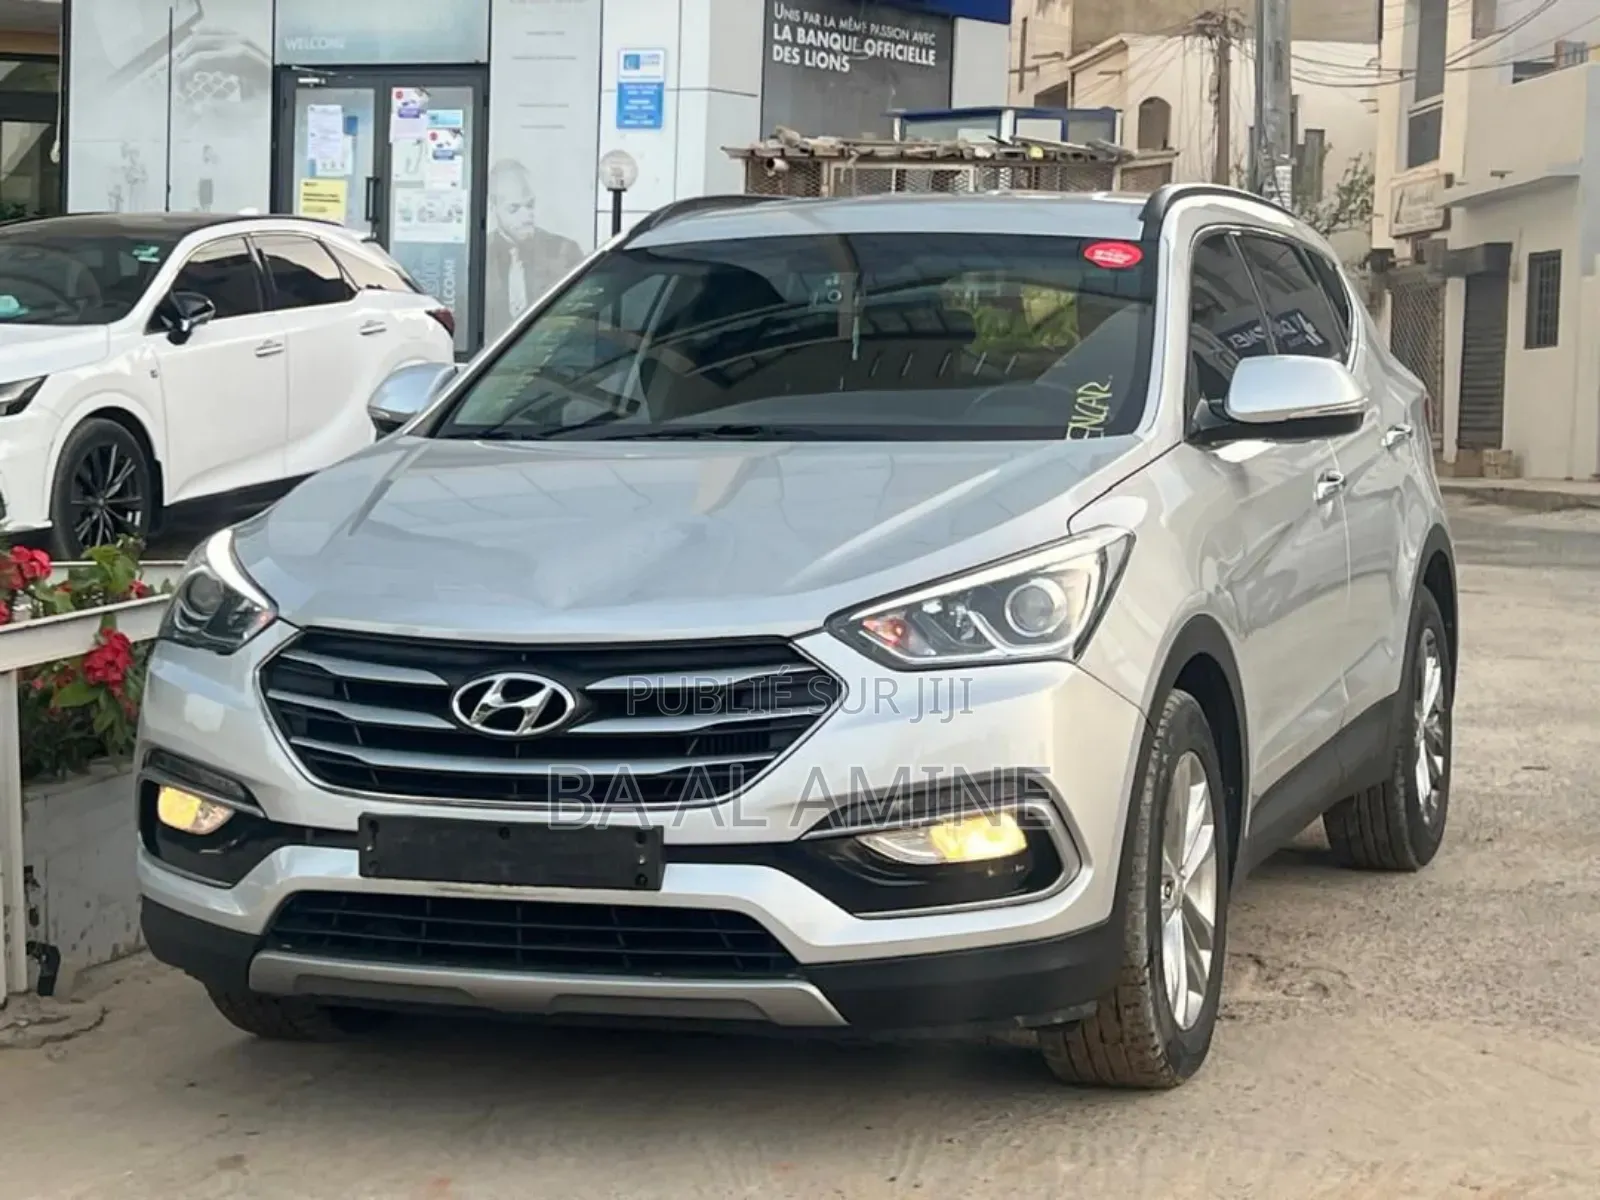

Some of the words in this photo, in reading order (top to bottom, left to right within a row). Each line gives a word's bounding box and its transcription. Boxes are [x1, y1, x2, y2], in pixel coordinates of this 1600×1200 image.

[773, 23, 792, 43] LA
[797, 27, 865, 53] BANQUE
[864, 38, 936, 66] OFFICIELLE
[774, 2, 800, 22] UNIS
[803, 11, 821, 26] PAR
[823, 15, 836, 28] LA
[839, 16, 867, 34] MÊME
[869, 23, 909, 41] PASSION
[912, 31, 936, 46] AVEC
[772, 44, 800, 65] DES
[804, 49, 850, 72] LIONS
